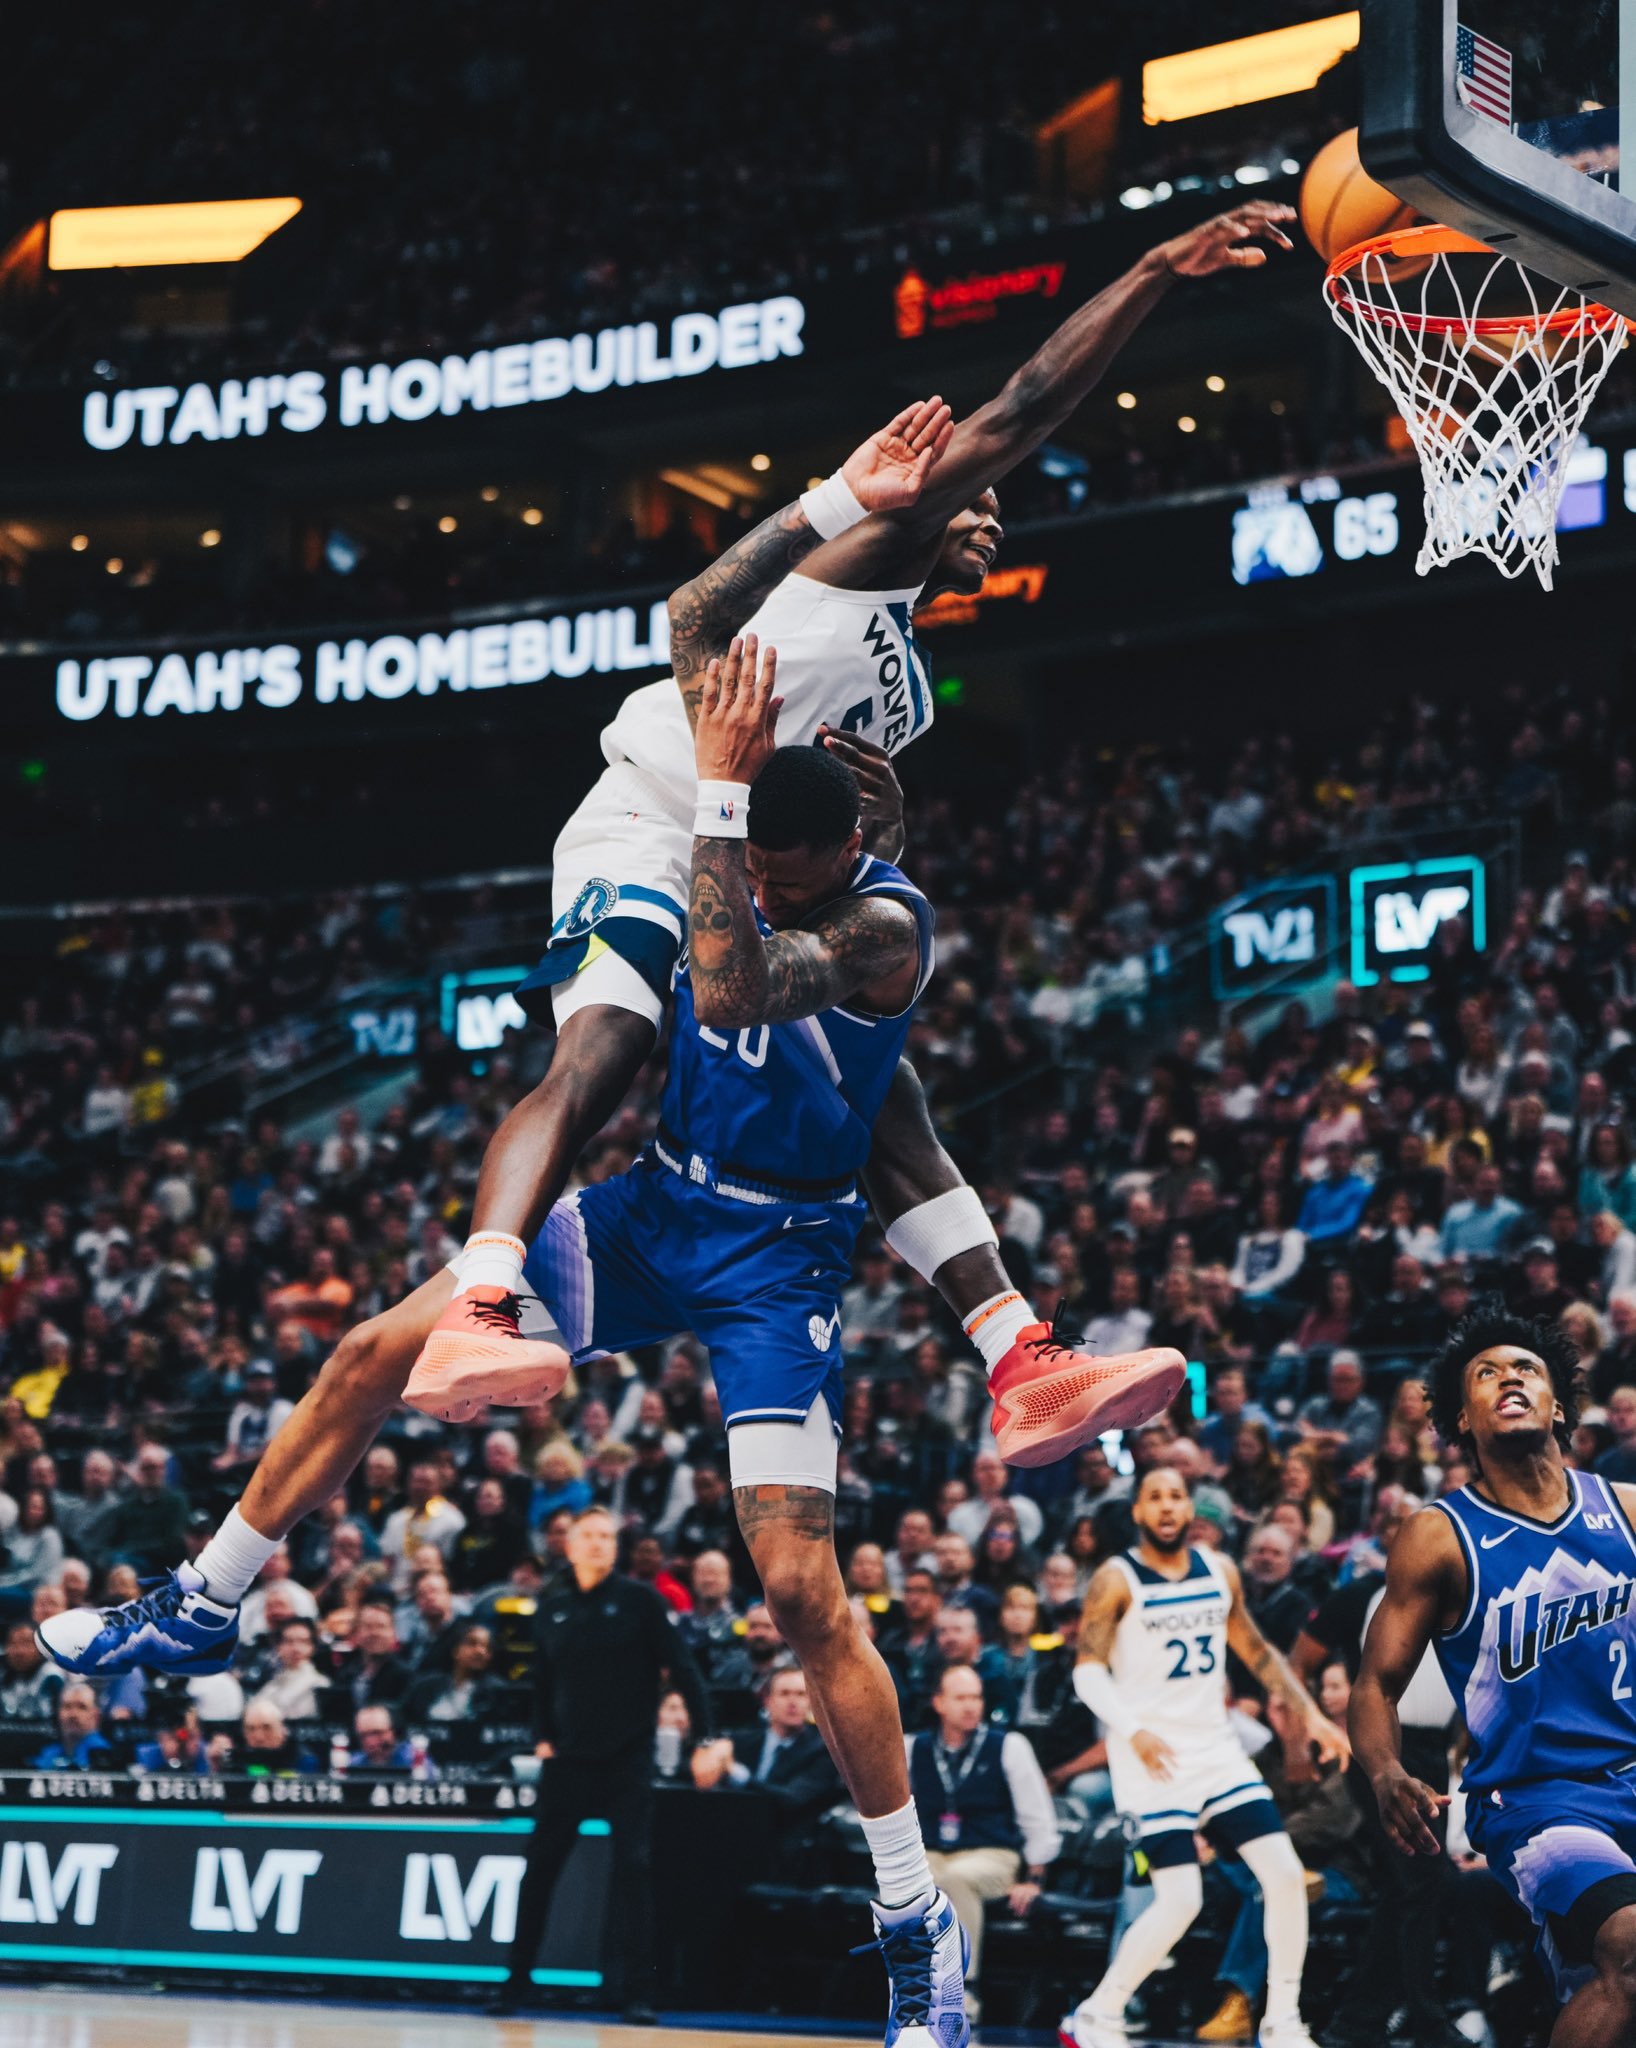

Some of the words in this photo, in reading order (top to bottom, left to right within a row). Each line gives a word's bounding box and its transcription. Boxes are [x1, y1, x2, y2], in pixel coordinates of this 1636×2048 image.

[83, 370, 328, 452] UTAH'S
[339, 295, 806, 428] HOMEBUILDER
[1333, 492, 1399, 560] 65
[55, 644, 304, 722] UTAH'S
[862, 612, 909, 754] WOLVES
[1583, 1512, 1614, 1530] LVT
[1142, 1607, 1225, 1632] WOLVES
[1496, 1576, 1635, 1683] UTAH
[1166, 1634, 1216, 1680] 23
[49, 1778, 113, 1799] DELTA
[157, 1778, 226, 1800] DELTA
[272, 1780, 343, 1803] DELTA
[393, 1782, 466, 1805] DELTA
[0, 1841, 120, 1926] LVT
[190, 1847, 324, 1935] LVT
[400, 1852, 528, 1944] LVT
